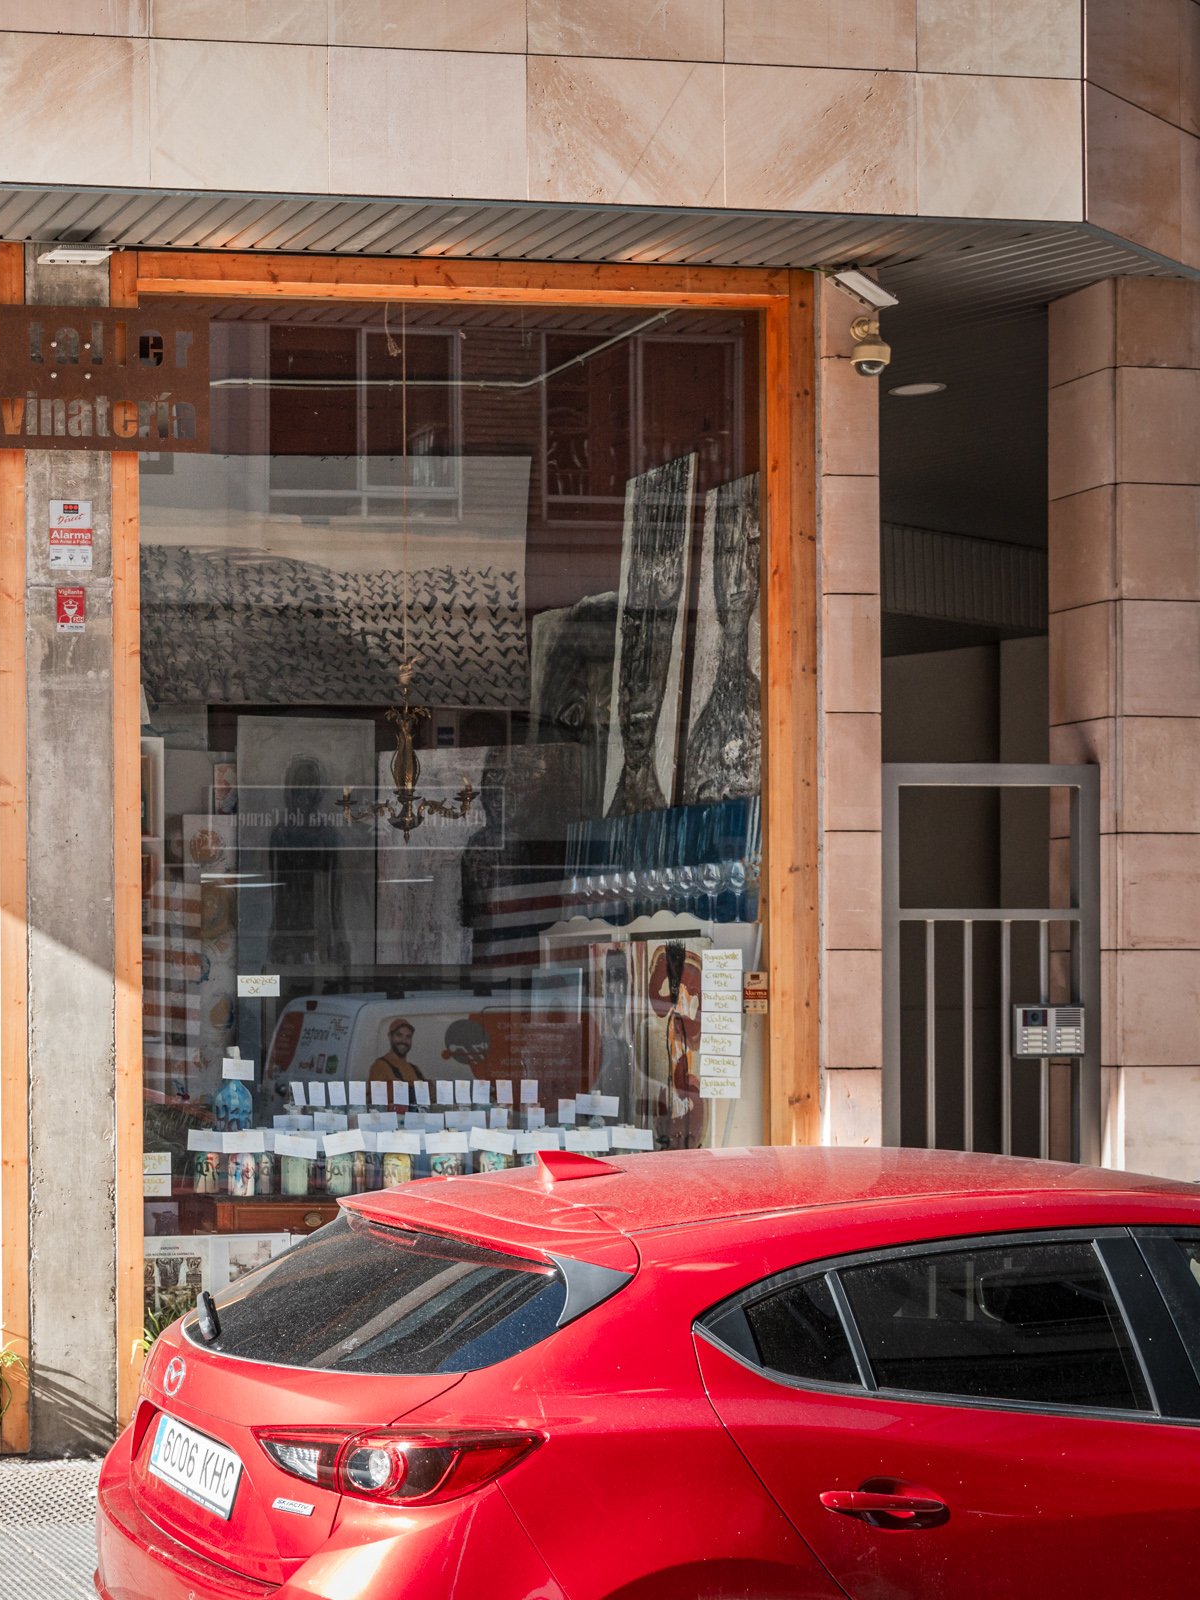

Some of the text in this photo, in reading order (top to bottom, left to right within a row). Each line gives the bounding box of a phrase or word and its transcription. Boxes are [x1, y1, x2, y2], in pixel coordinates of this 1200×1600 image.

[29, 319, 194, 368] taller
[1, 390, 197, 440] vinatería
[51, 530, 91, 540] Alarma
[199, 1449, 235, 1498] KHC
